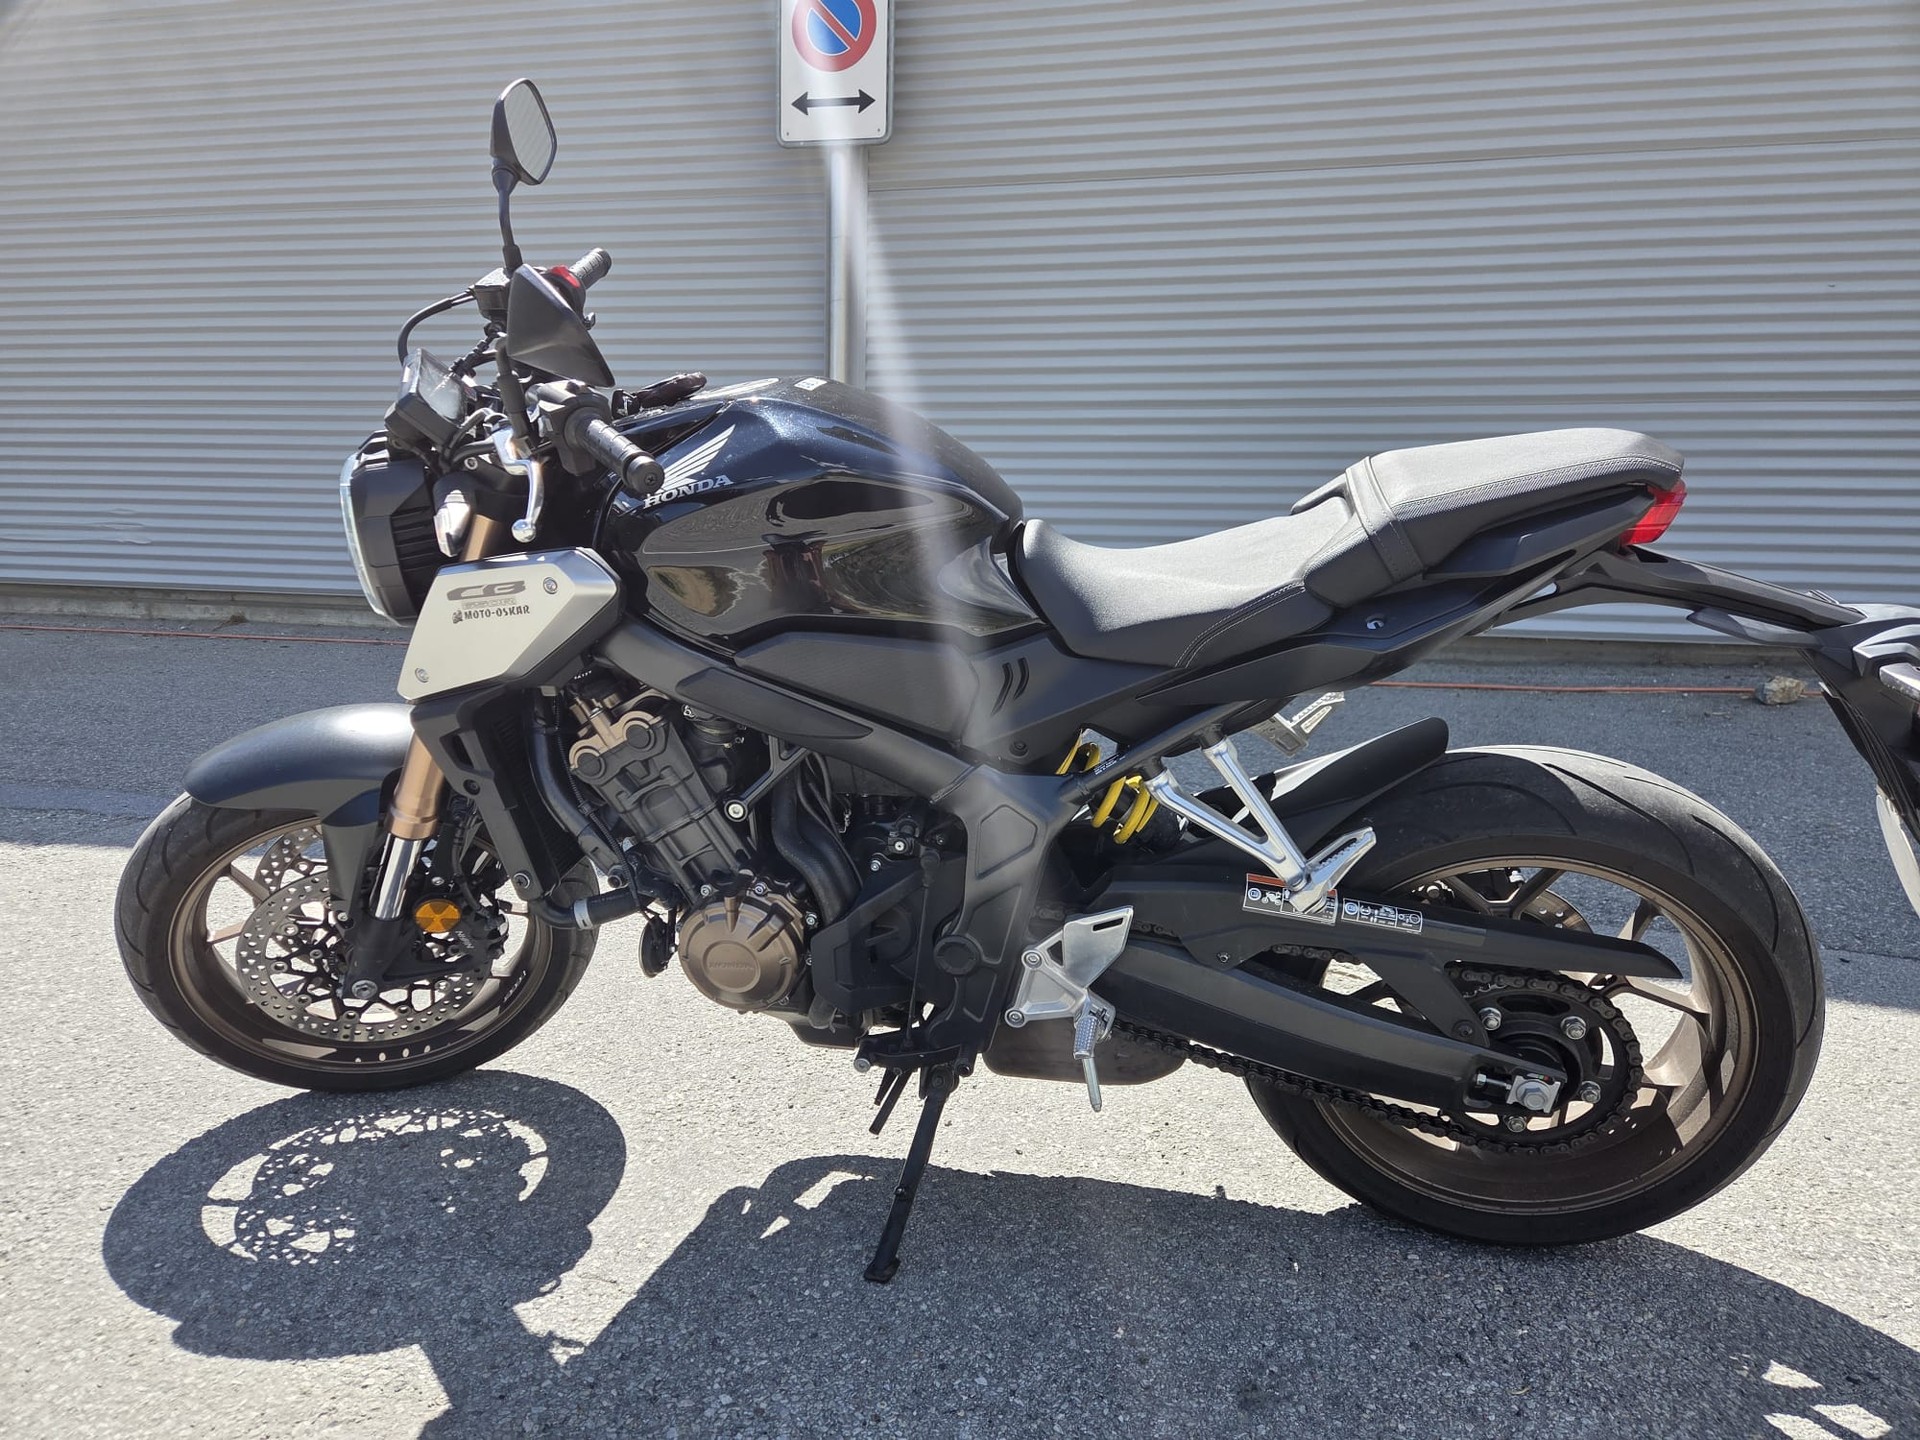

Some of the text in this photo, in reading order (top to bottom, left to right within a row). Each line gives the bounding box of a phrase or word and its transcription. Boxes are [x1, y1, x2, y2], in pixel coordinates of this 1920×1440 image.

[643, 474, 734, 509] HONDA
[447, 580, 526, 601] CB
[464, 605, 530, 620] MOTO-OSKAR
